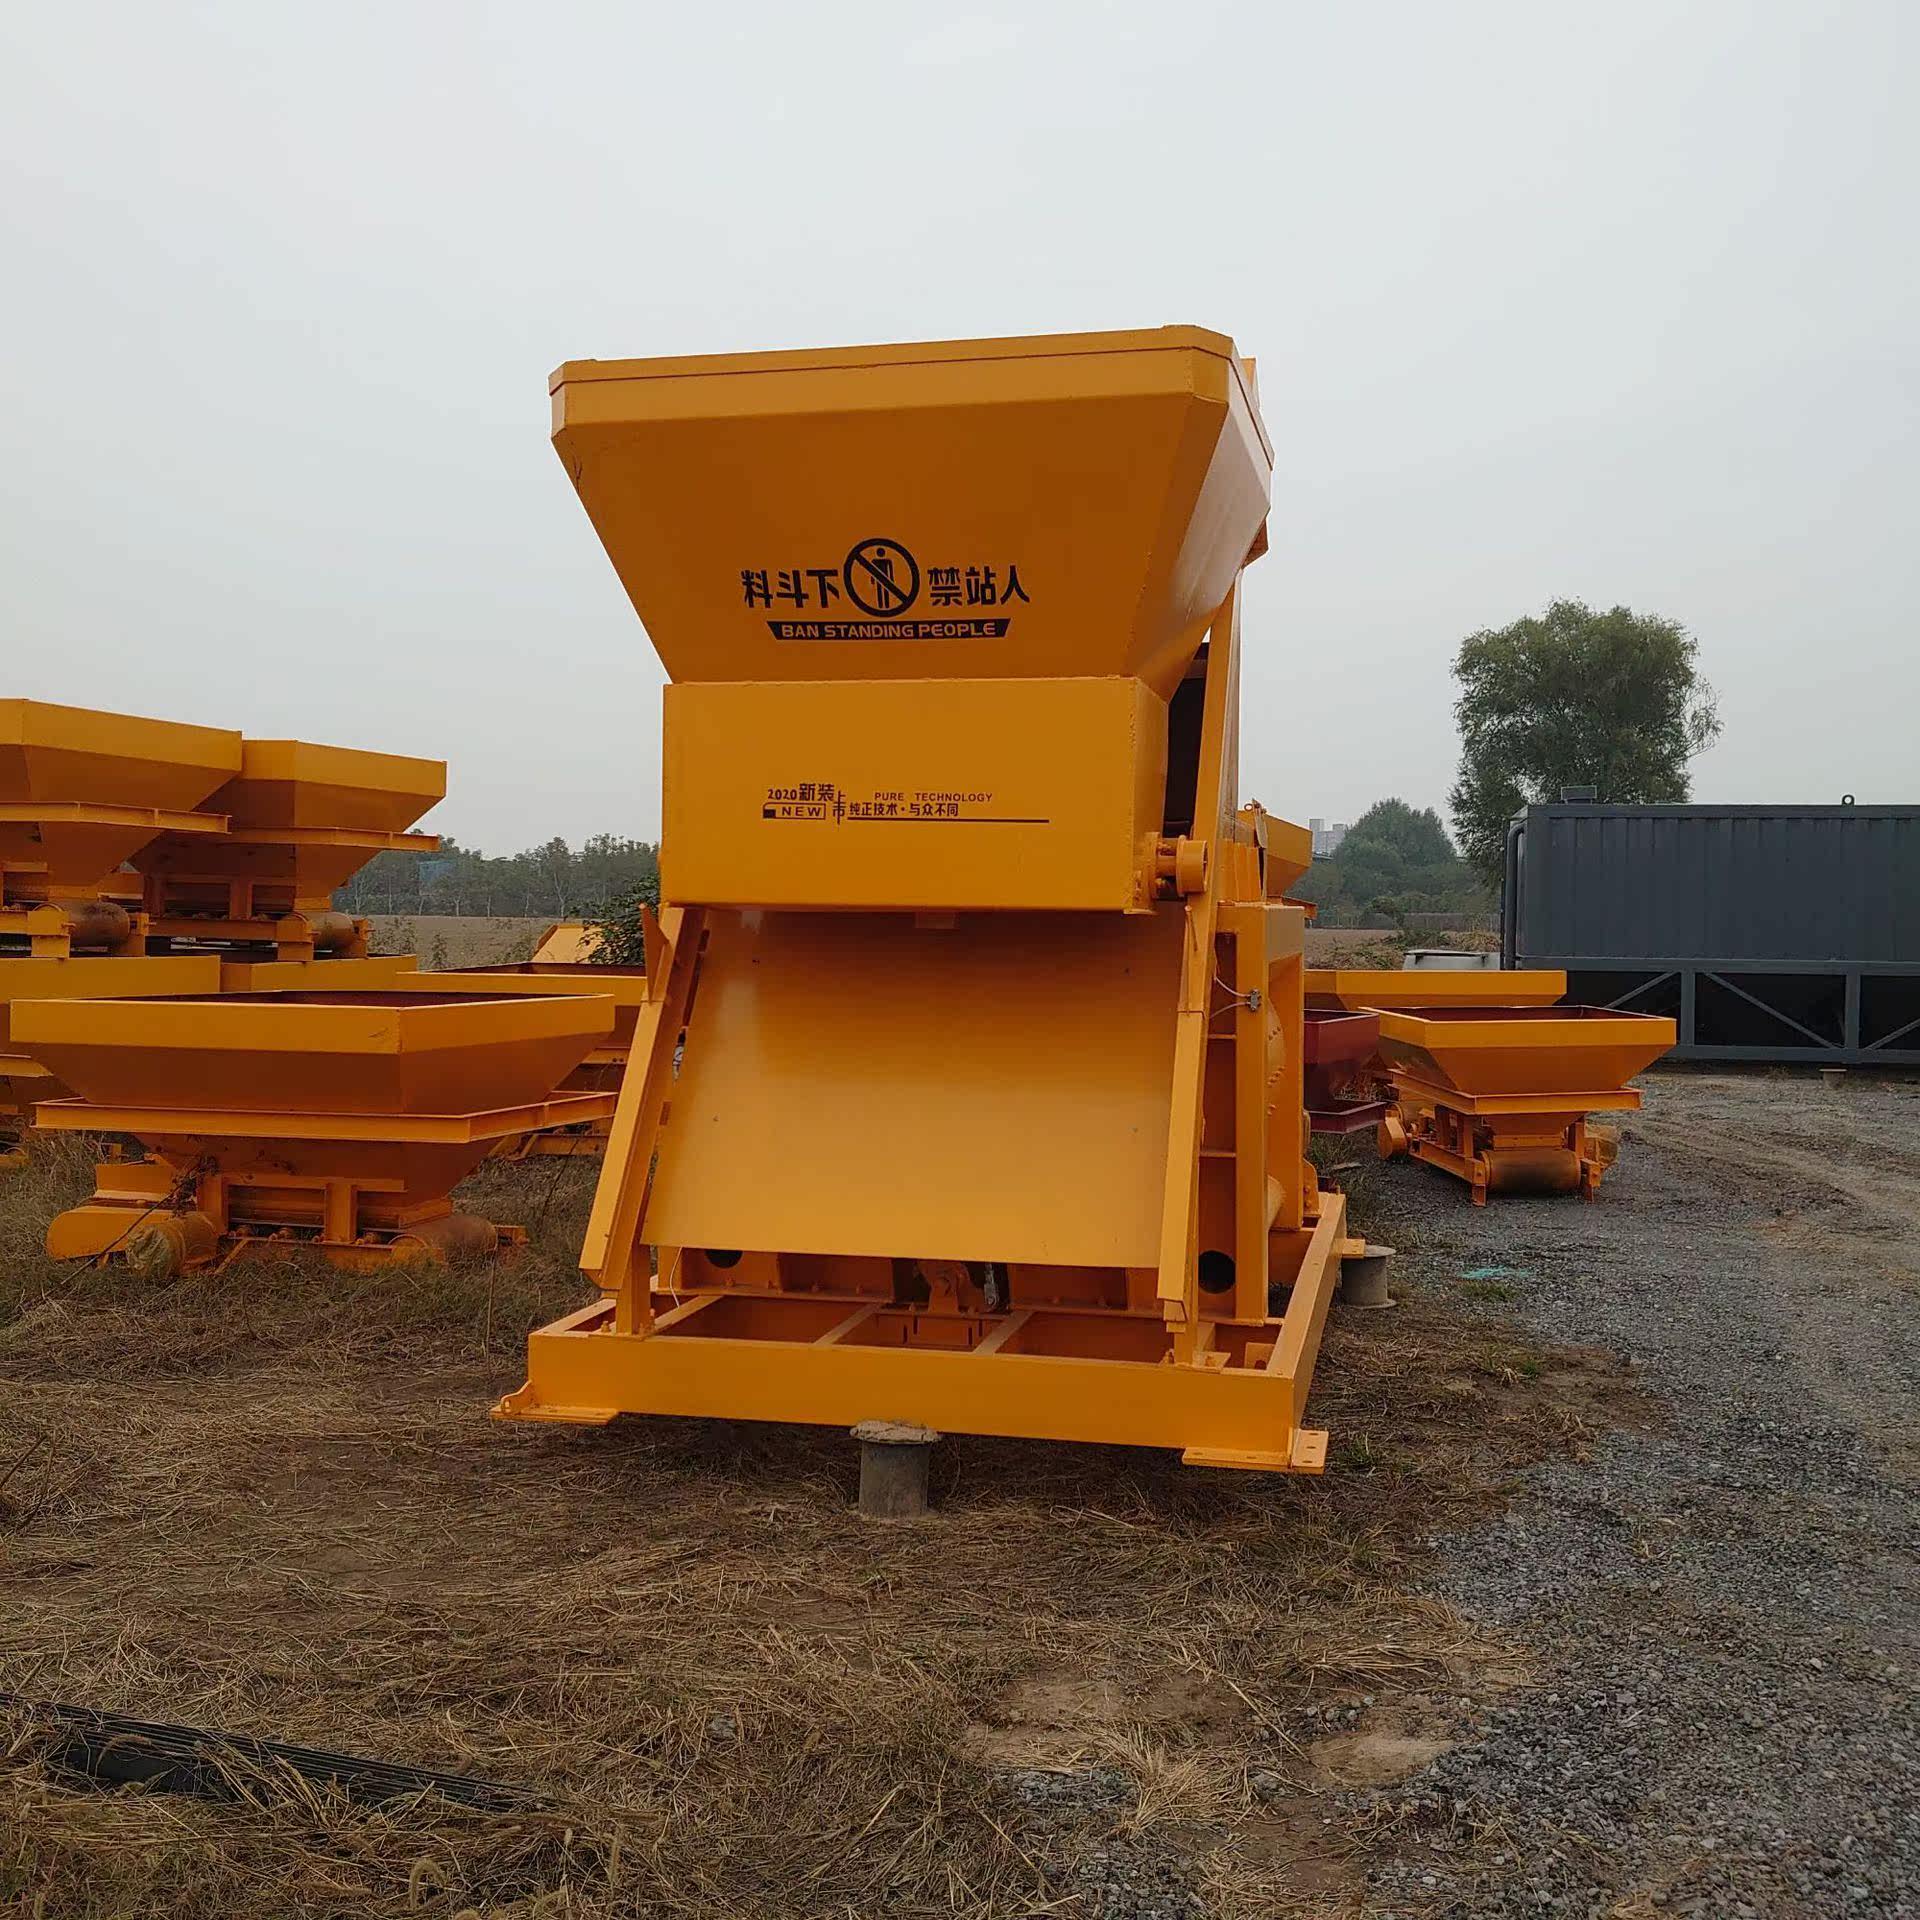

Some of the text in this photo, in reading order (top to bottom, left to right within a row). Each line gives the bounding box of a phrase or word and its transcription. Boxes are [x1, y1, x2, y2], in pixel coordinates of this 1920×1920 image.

[740, 564, 1031, 609] 料斗下 禁站人
[781, 621, 996, 639] BAN STANDING PEOPLE
[874, 792, 993, 802] PURE TECHNOLOGY
[781, 806, 822, 817] NEW
